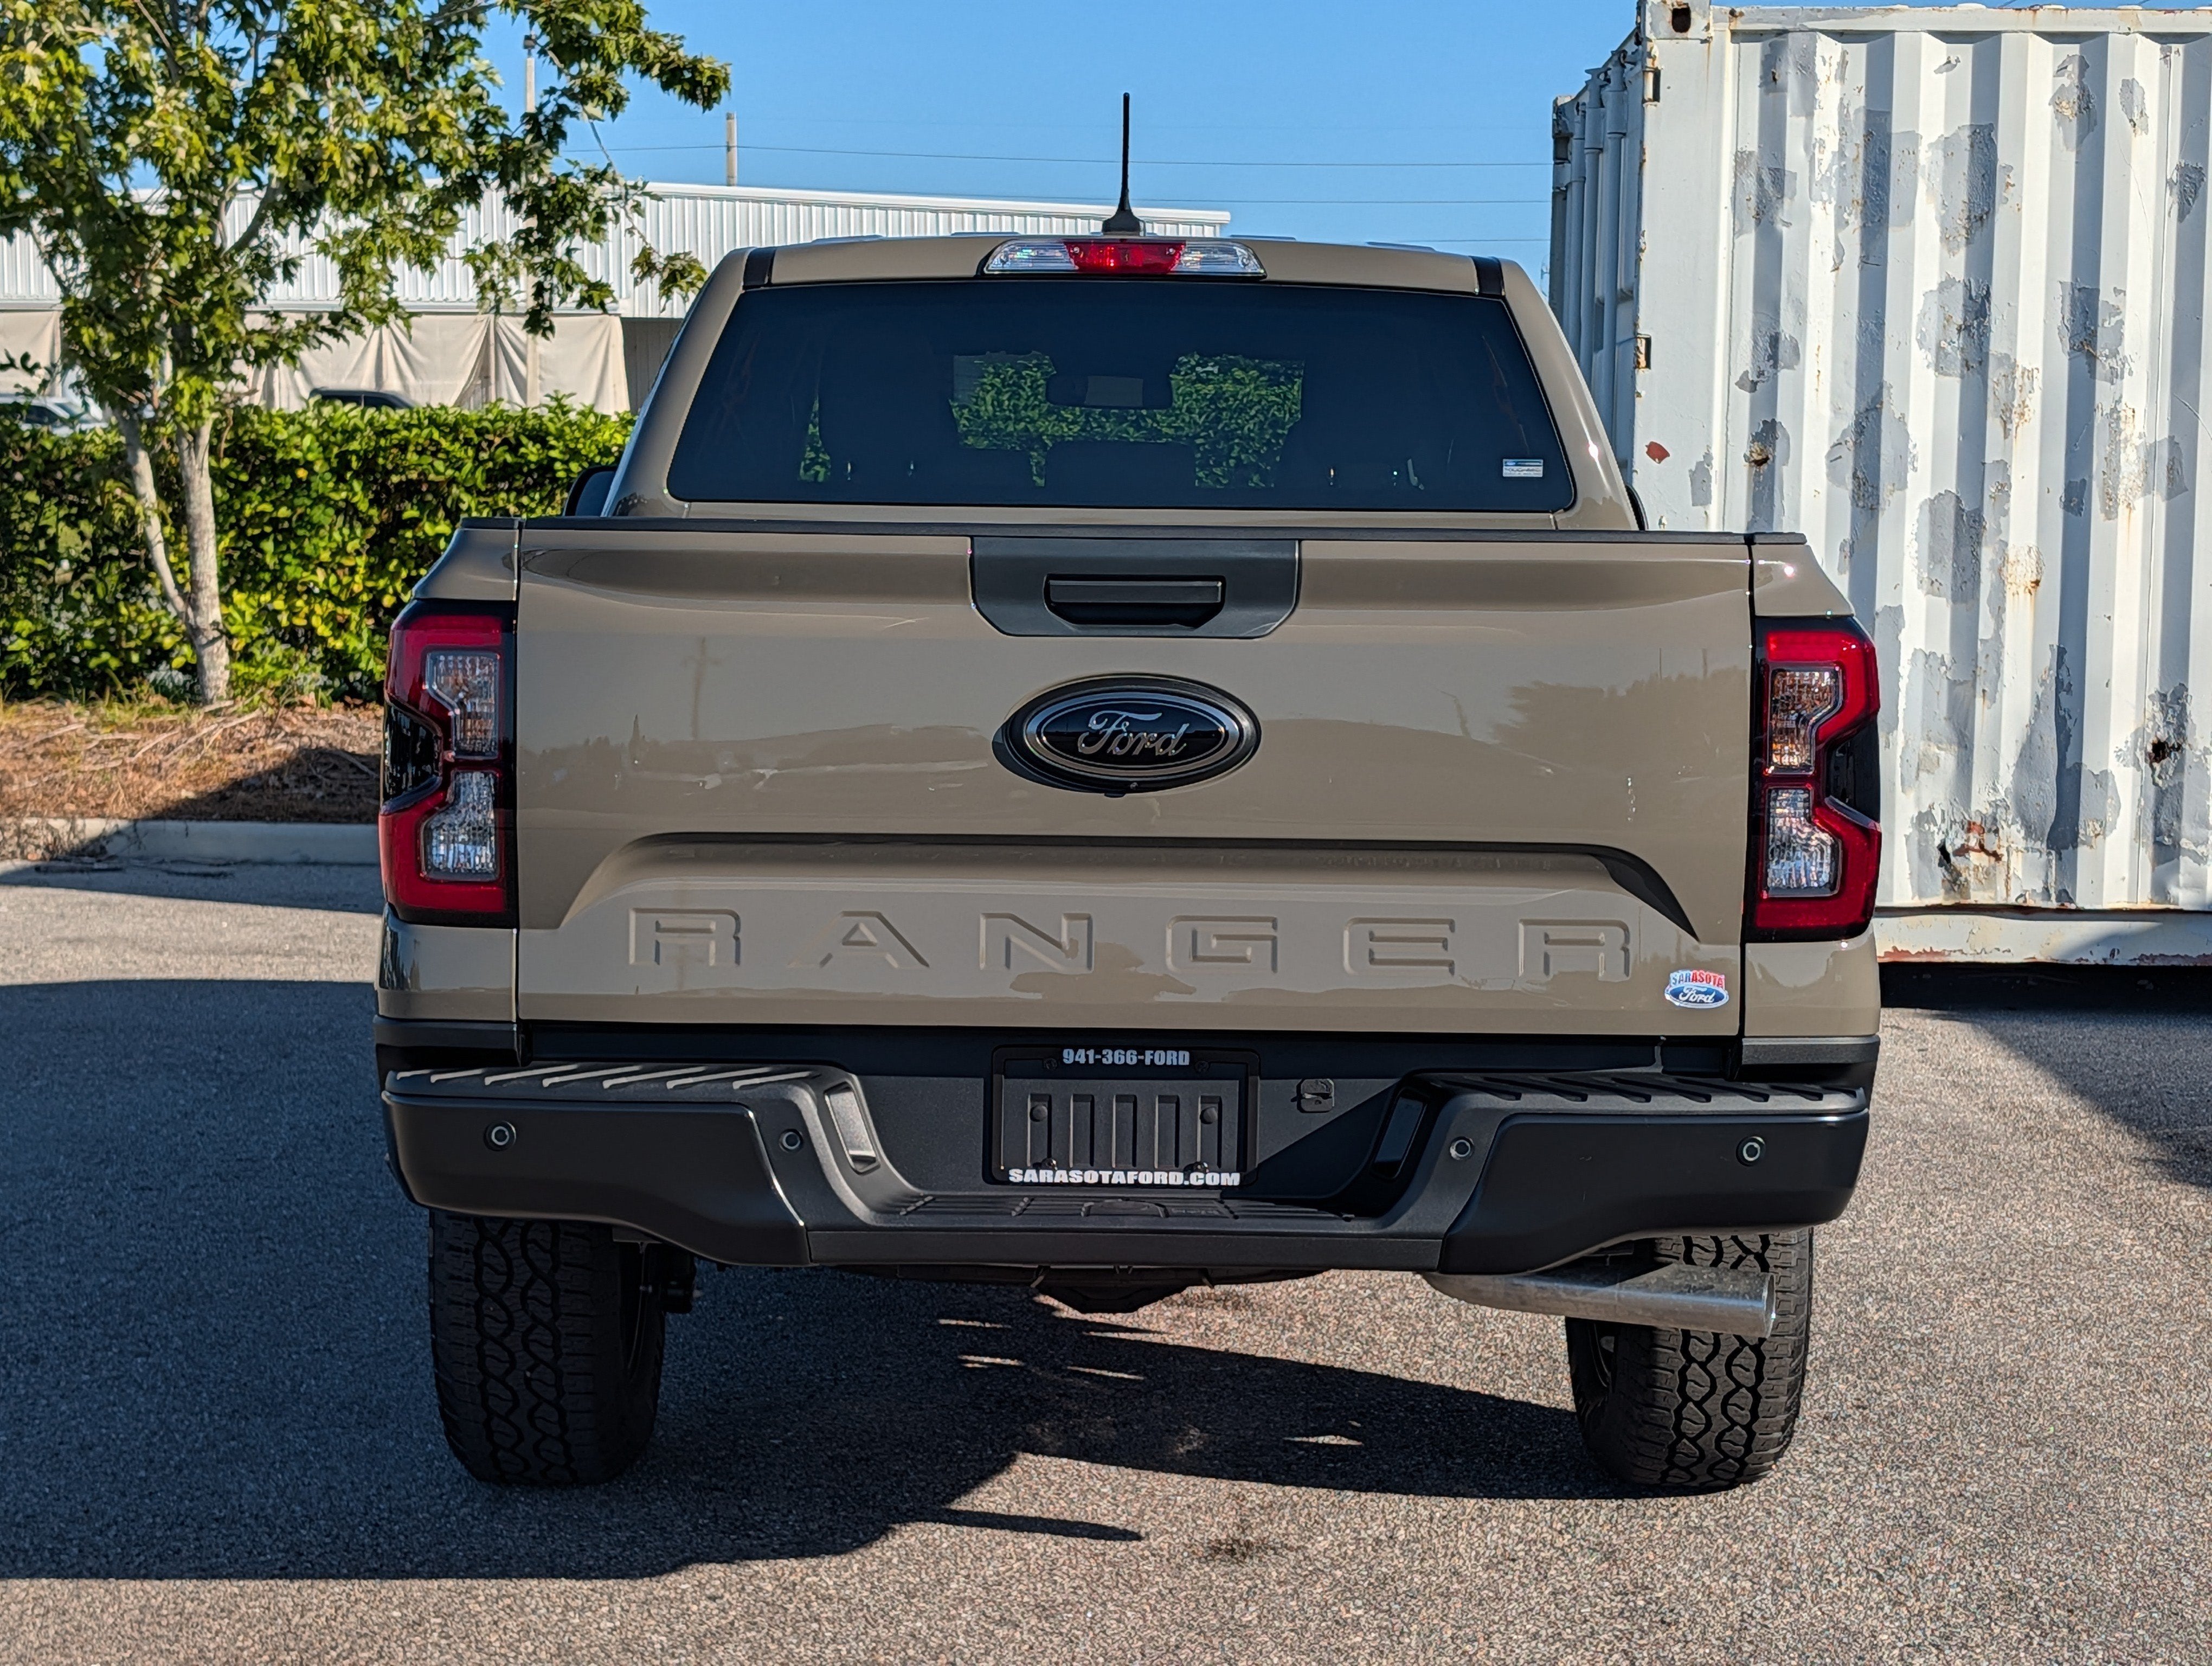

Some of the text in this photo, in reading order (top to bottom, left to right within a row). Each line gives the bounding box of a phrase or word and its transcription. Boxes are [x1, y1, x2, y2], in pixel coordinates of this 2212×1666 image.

[1077, 710, 1189, 756] Ford
[628, 908, 1630, 977] RANGER
[1672, 971, 1724, 988] SARASOTA
[1679, 986, 1716, 1003] Ford
[1063, 1049, 1190, 1066] 941-366-FORD
[1009, 1169, 1240, 1186] SARASOTAFORD.COM
